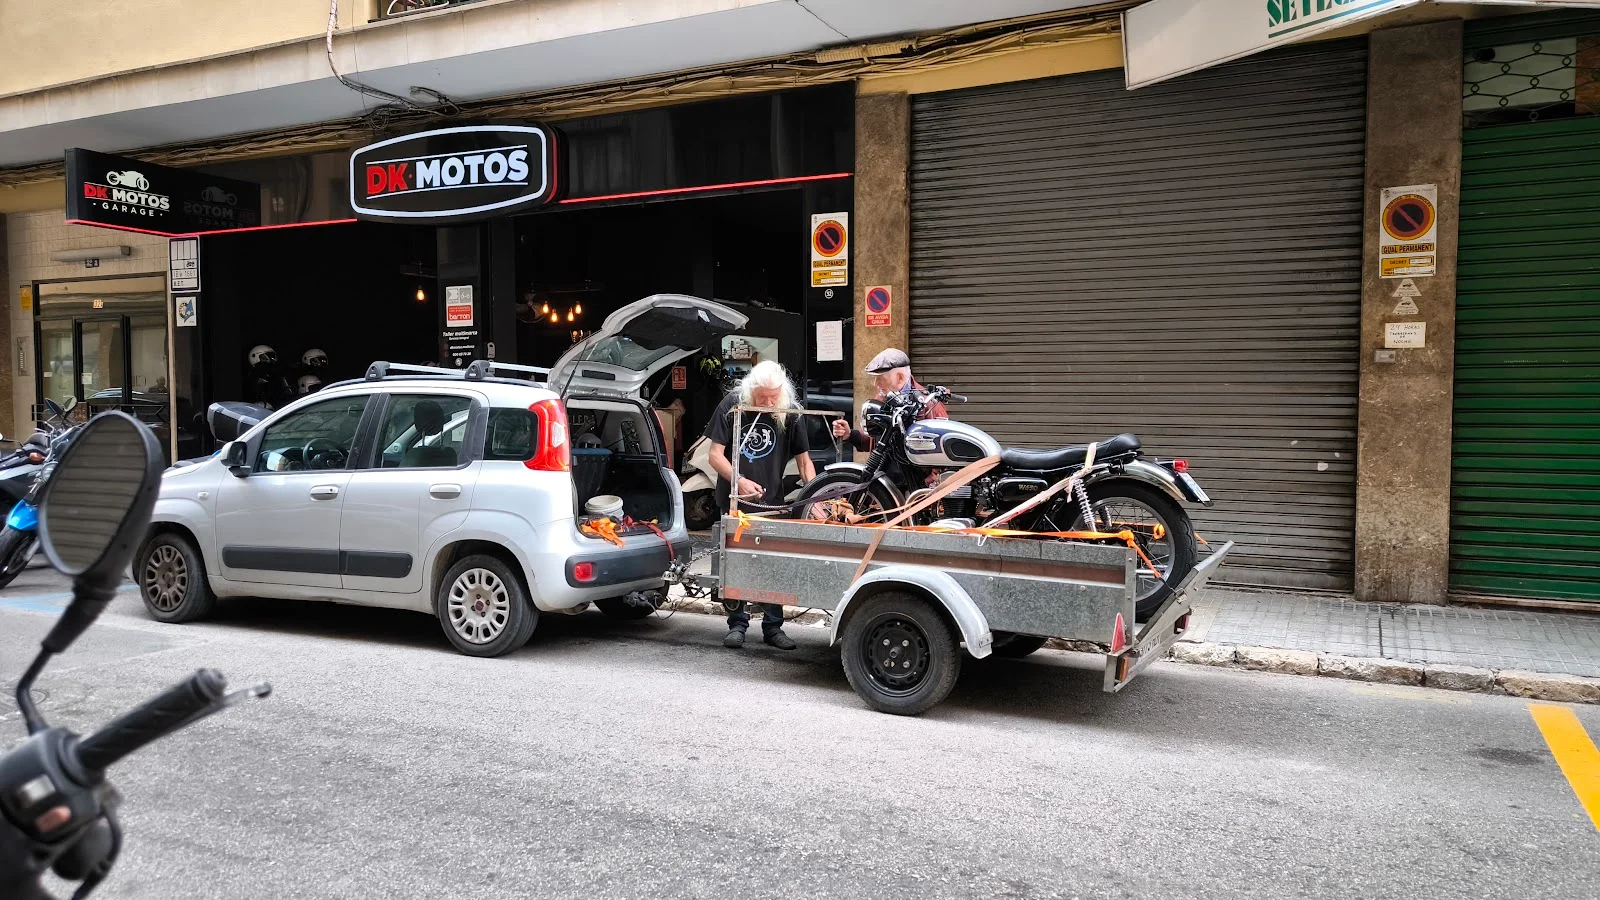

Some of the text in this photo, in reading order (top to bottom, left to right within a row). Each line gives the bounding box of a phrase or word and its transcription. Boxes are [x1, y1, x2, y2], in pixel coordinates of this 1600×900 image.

[366, 150, 529, 195] DK MOTOS
[84, 183, 170, 210] DK MOTOS
[102, 202, 154, 216] GARAGE
[1399, 244, 1432, 253] PERMANENT
